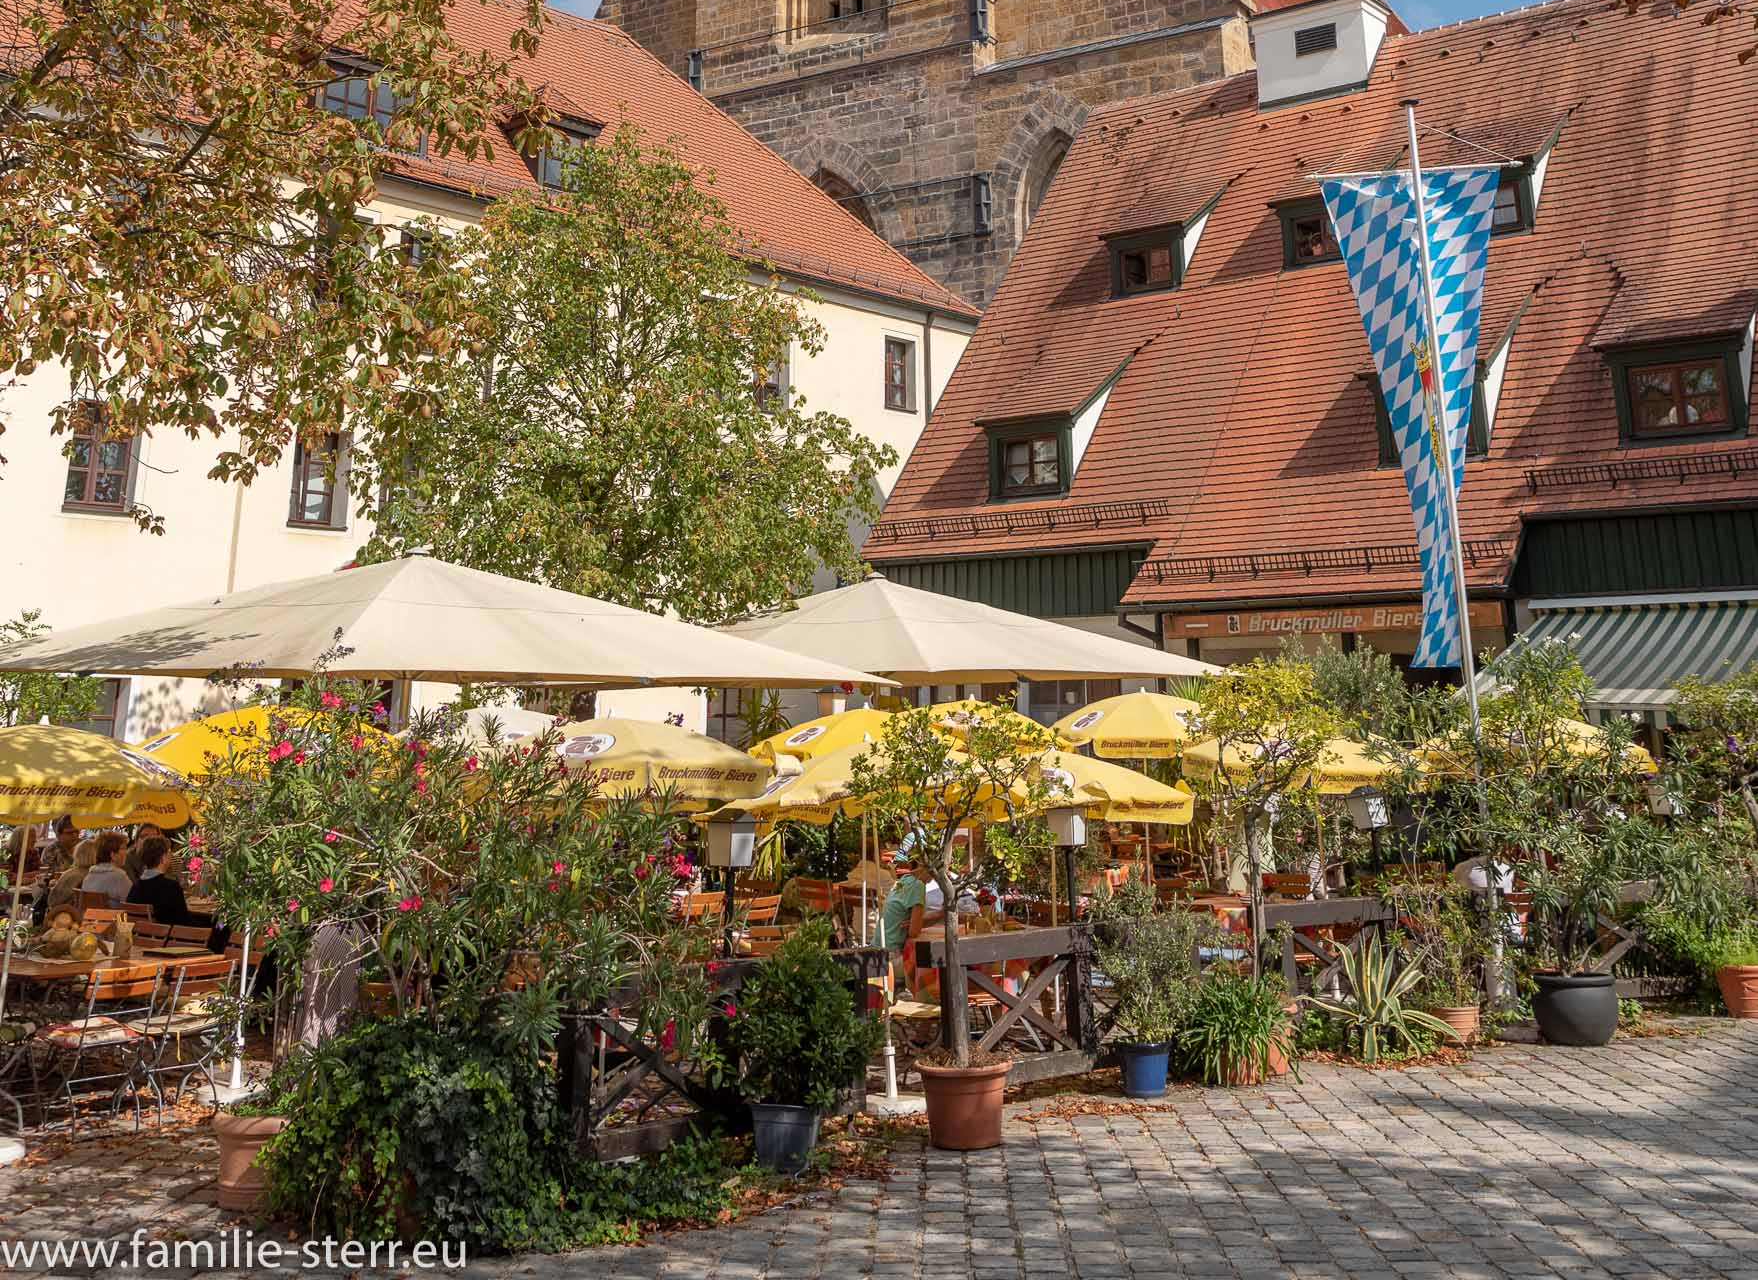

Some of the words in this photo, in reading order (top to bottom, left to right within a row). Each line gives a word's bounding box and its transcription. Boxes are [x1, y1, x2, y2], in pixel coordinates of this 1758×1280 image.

[1248, 610, 1363, 632] Bruckmüller
[1374, 608, 1424, 627] Biere
[658, 766, 725, 780] Bruckmüller
[725, 768, 758, 782] Biere
[86, 785, 125, 799] Biere
